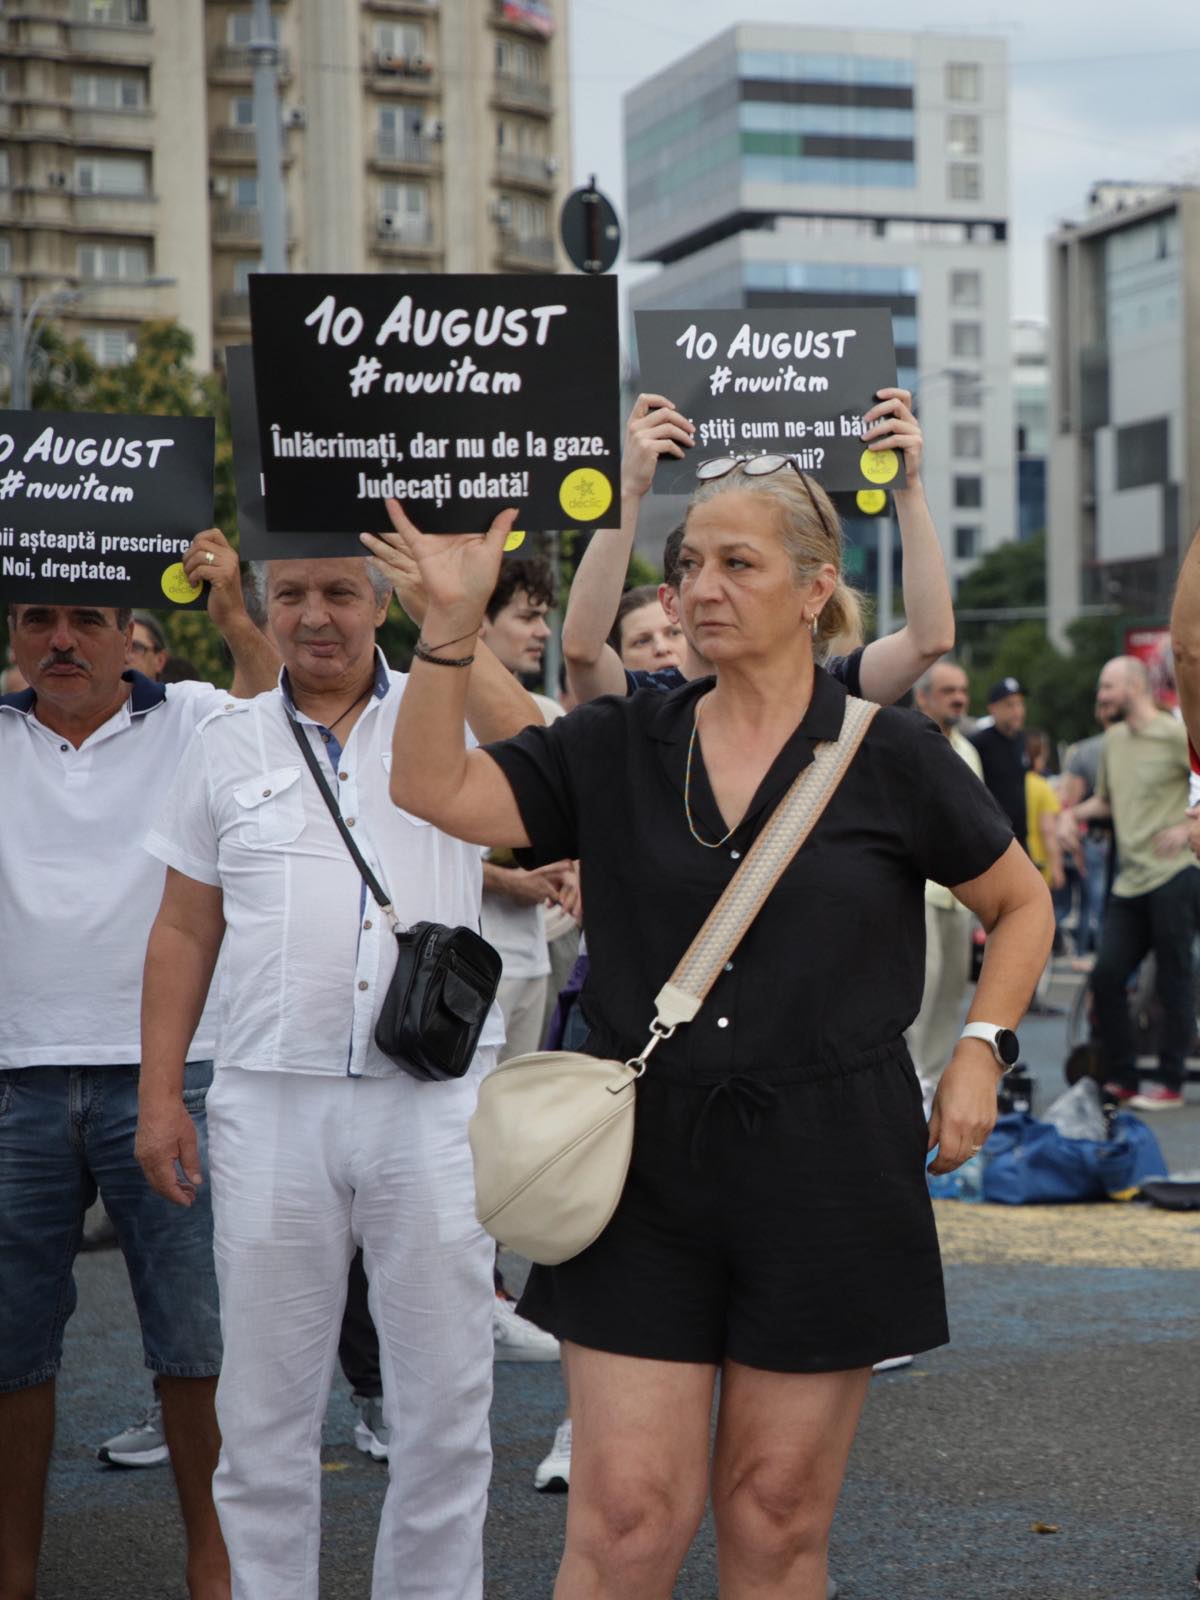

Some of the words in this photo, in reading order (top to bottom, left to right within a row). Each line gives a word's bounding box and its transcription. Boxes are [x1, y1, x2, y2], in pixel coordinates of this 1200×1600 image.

[305, 296, 363, 346] 10
[376, 296, 567, 346] AUGUST
[676, 325, 717, 359] 10
[727, 324, 856, 359] AUGUST
[349, 356, 521, 397] #nuuitam
[710, 365, 828, 395] #nuuitam
[0, 434, 14, 462] 0
[23, 427, 174, 468] AUGUST
[271, 424, 403, 467] Înlăcrimați,
[410, 432, 449, 458] dar
[457, 439, 484, 457] nu
[492, 432, 519, 457] de
[527, 431, 546, 456] la
[554, 437, 609, 461] gaze.
[700, 419, 735, 446] știți
[742, 422, 779, 438] cum
[785, 421, 834, 437] ne-au
[358, 473, 451, 508] Judecați
[459, 472, 528, 498] odată!
[20, 530, 95, 553] așteaptă
[102, 533, 192, 555] prescriere
[3, 557, 35, 579] Noi,
[42, 558, 130, 582] dreptatea.
